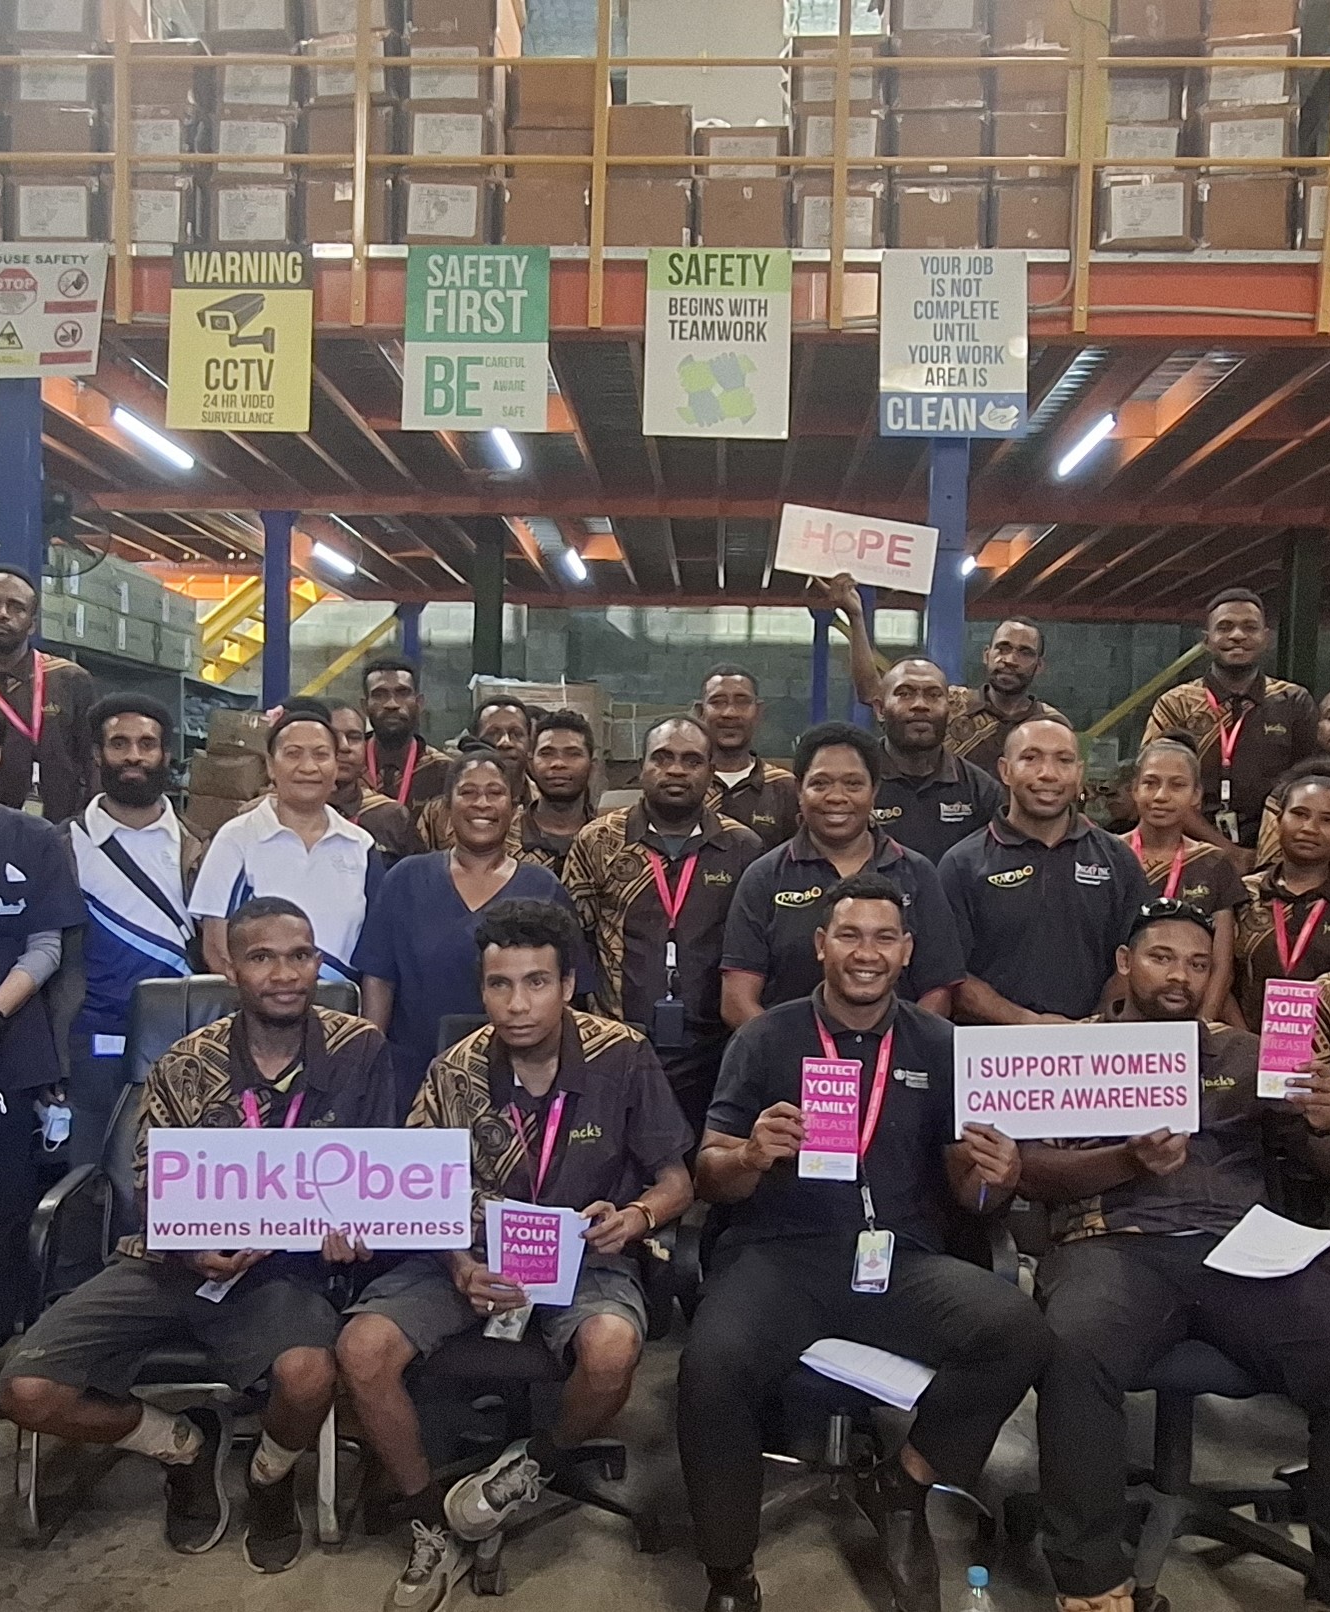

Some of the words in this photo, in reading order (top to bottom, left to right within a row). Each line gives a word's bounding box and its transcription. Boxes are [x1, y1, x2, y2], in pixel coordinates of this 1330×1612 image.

[35, 254, 89, 265] SAFETY
[184, 251, 302, 284] WARNING
[920, 256, 961, 275] YOUR
[965, 256, 994, 275] JOB
[427, 254, 529, 288] SAFETY
[668, 252, 770, 287] SAFETY
[931, 278, 946, 297] IS
[950, 278, 983, 297] NOT
[425, 289, 528, 334] FIRST
[669, 297, 724, 317] BEGINS
[729, 298, 768, 317] WITH
[913, 300, 1000, 320] COMPLETE
[668, 319, 768, 342] TEAMWORK
[933, 322, 980, 342] UNTIL
[484, 356, 526, 368] CAREFUL
[908, 345, 951, 364] YOUR
[956, 345, 1004, 364] WORK
[204, 358, 274, 391] CCTV
[924, 367, 968, 387] AREA
[973, 367, 987, 387] IS
[423, 355, 484, 417] BE
[202, 393, 218, 408] 24
[221, 394, 237, 408] HR
[241, 394, 274, 409] VIDEO
[201, 411, 274, 424] SURVEILLANCE
[502, 406, 526, 417] SAFE
[886, 396, 977, 432] CLEAN
[801, 519, 915, 568] HOPE
[776, 886, 823, 905] MOBO
[1268, 985, 1317, 998] PROTECT
[1267, 1000, 1314, 1018] YOUR
[1263, 1021, 1313, 1035] FAMILY
[805, 1063, 857, 1076] PROTECT
[967, 1057, 972, 1078] I
[980, 1055, 1084, 1078] SUPPORT
[1091, 1052, 1187, 1075] WOMENS
[805, 1078, 857, 1097] YOUR
[804, 1100, 857, 1115] FAMILY
[967, 1089, 1055, 1112] CANCER
[1060, 1085, 1188, 1110] AWARENESS
[152, 1143, 465, 1206] Pinktober
[152, 1221, 251, 1237] womens
[260, 1218, 331, 1237] health
[339, 1219, 465, 1237] awareness
[503, 1212, 559, 1226] PROTECT
[504, 1225, 558, 1242] YOUR
[503, 1242, 557, 1256] FAMILY
